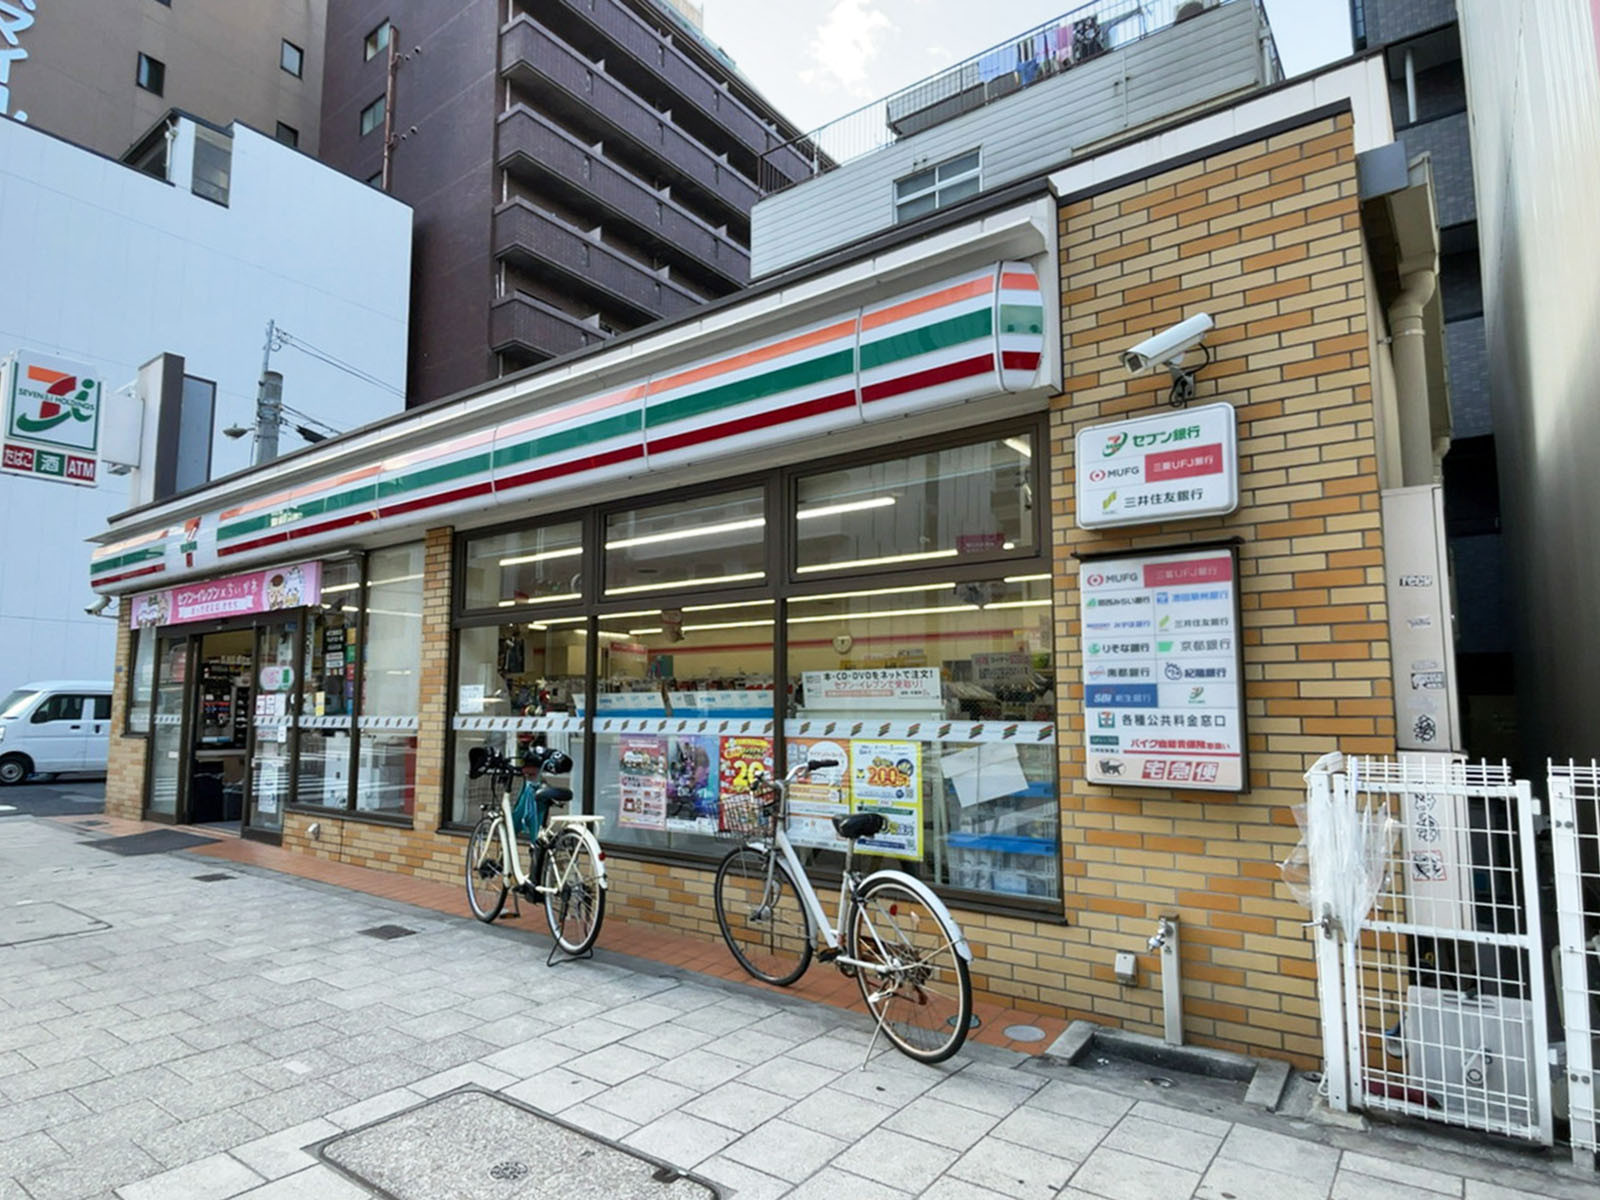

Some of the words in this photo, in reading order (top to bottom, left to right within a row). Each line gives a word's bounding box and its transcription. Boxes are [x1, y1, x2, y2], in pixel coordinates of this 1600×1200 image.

[1132, 424, 1201, 448] セブン銀行
[4, 448, 33, 468] たばこ
[40, 454, 60, 473] 酒
[67, 458, 95, 478] ATM
[1107, 465, 1140, 479] MUFG
[1124, 487, 1204, 509] 三井住友銀行
[1105, 572, 1139, 583] MUFG
[1174, 616, 1229, 628] 三井住友銀行
[1102, 642, 1150, 654] りそな銀行
[1180, 638, 1231, 652] 京都銀行
[1107, 667, 1150, 678] 南都銀行
[1093, 693, 1112, 703] SBI
[1121, 714, 1226, 728] 各種公共料金窓口
[1142, 760, 1219, 783] 宅急便
